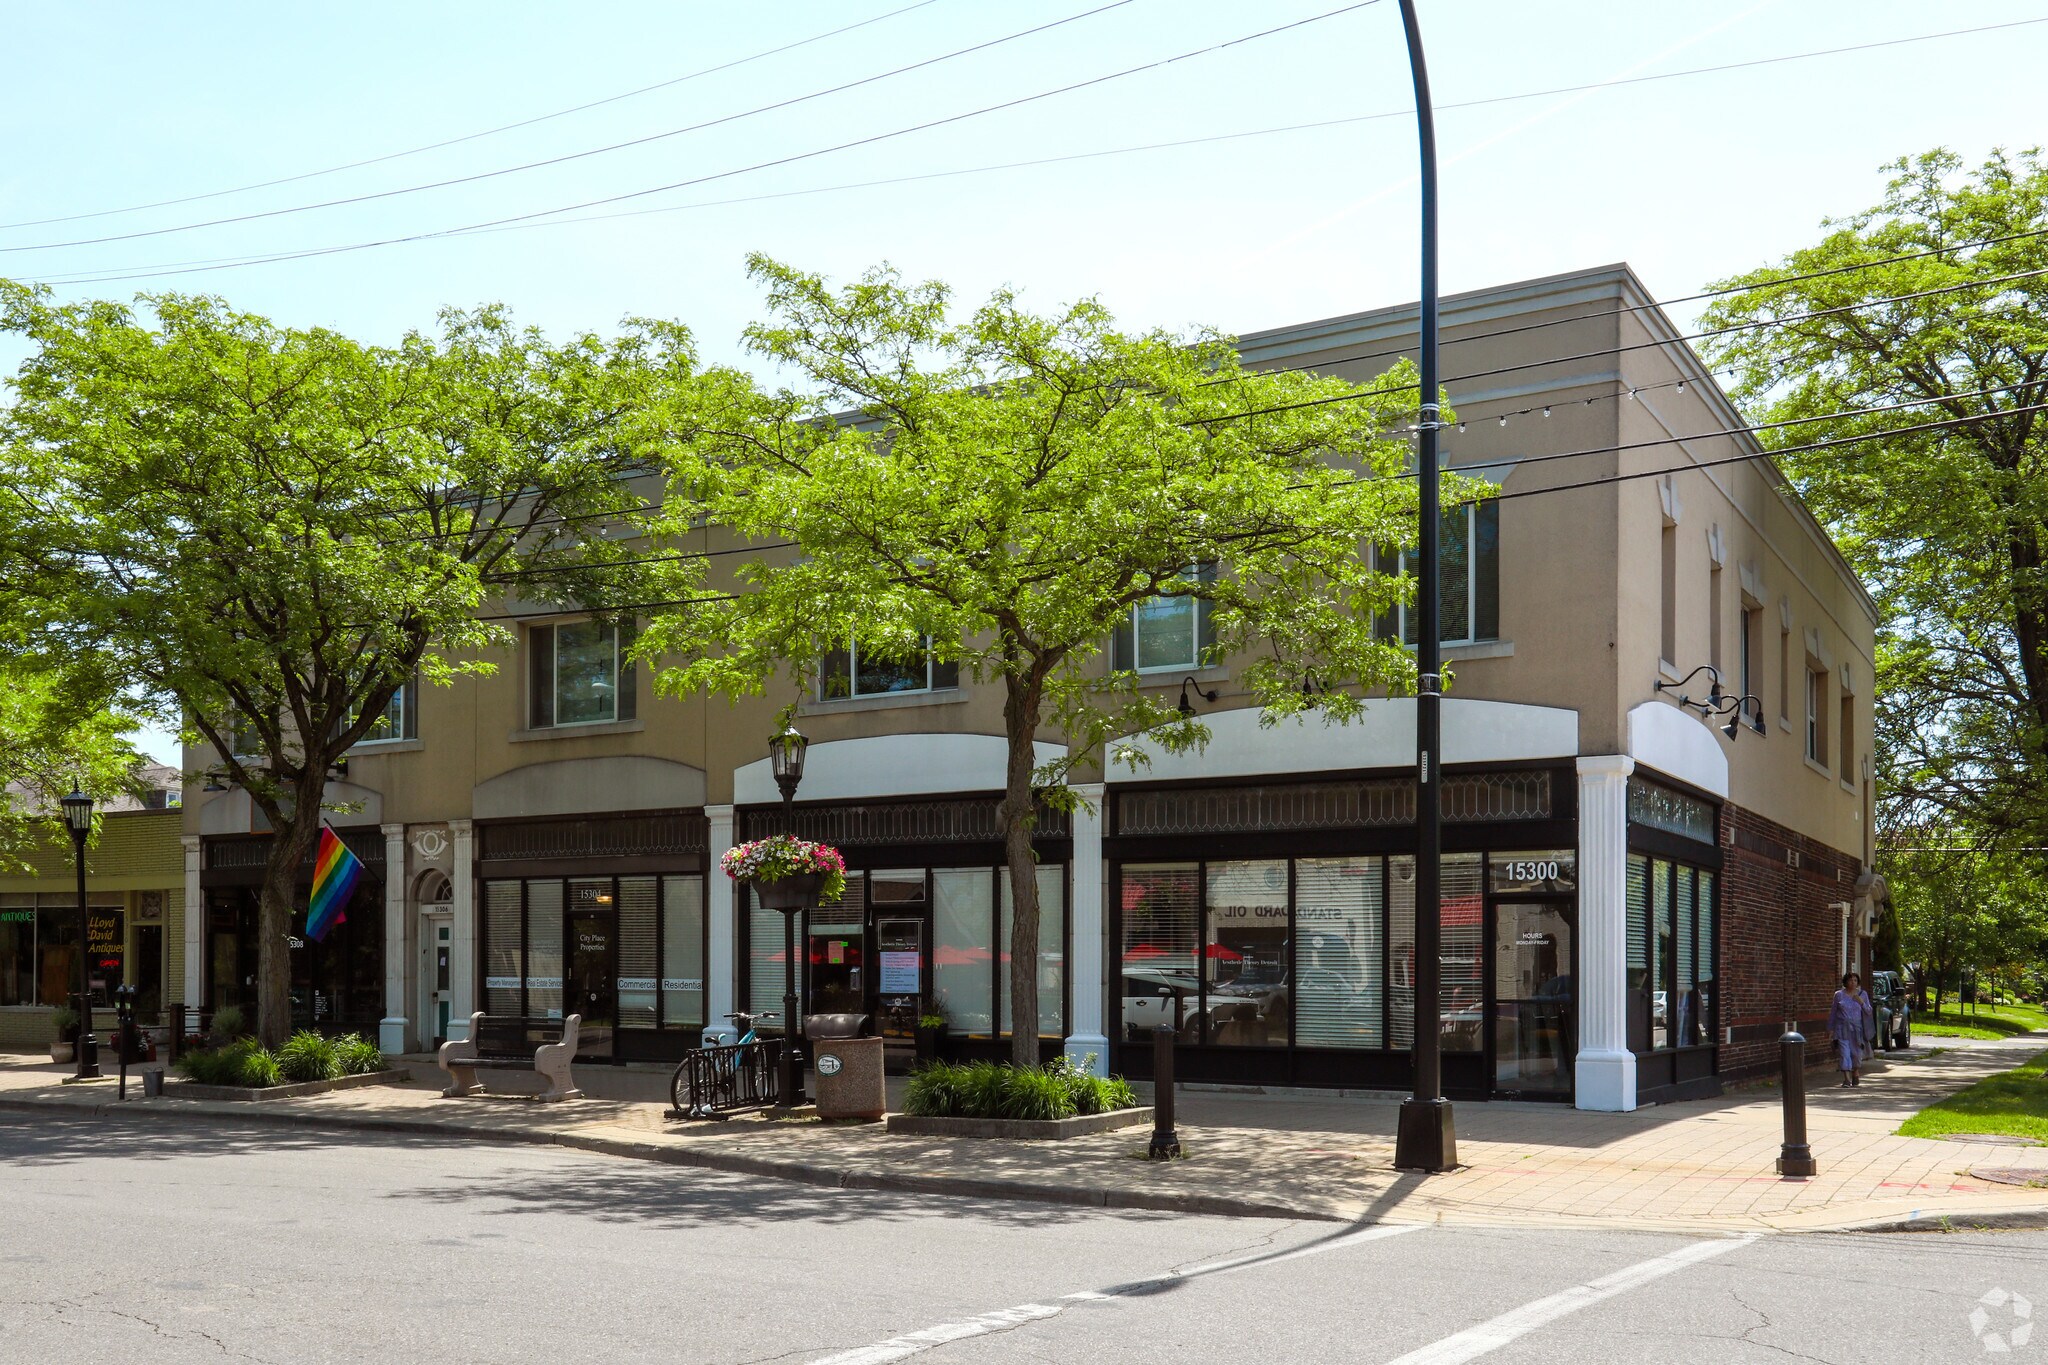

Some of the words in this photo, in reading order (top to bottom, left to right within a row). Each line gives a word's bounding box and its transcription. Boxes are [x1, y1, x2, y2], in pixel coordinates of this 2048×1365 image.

[1506, 862, 1558, 880] 15300
[1, 912, 36, 922] ANTIQUES
[90, 930, 113, 940] David
[580, 935, 590, 943] City
[88, 943, 124, 954] Antiques
[618, 980, 656, 988] Commercia
[664, 980, 702, 989] Residentia
